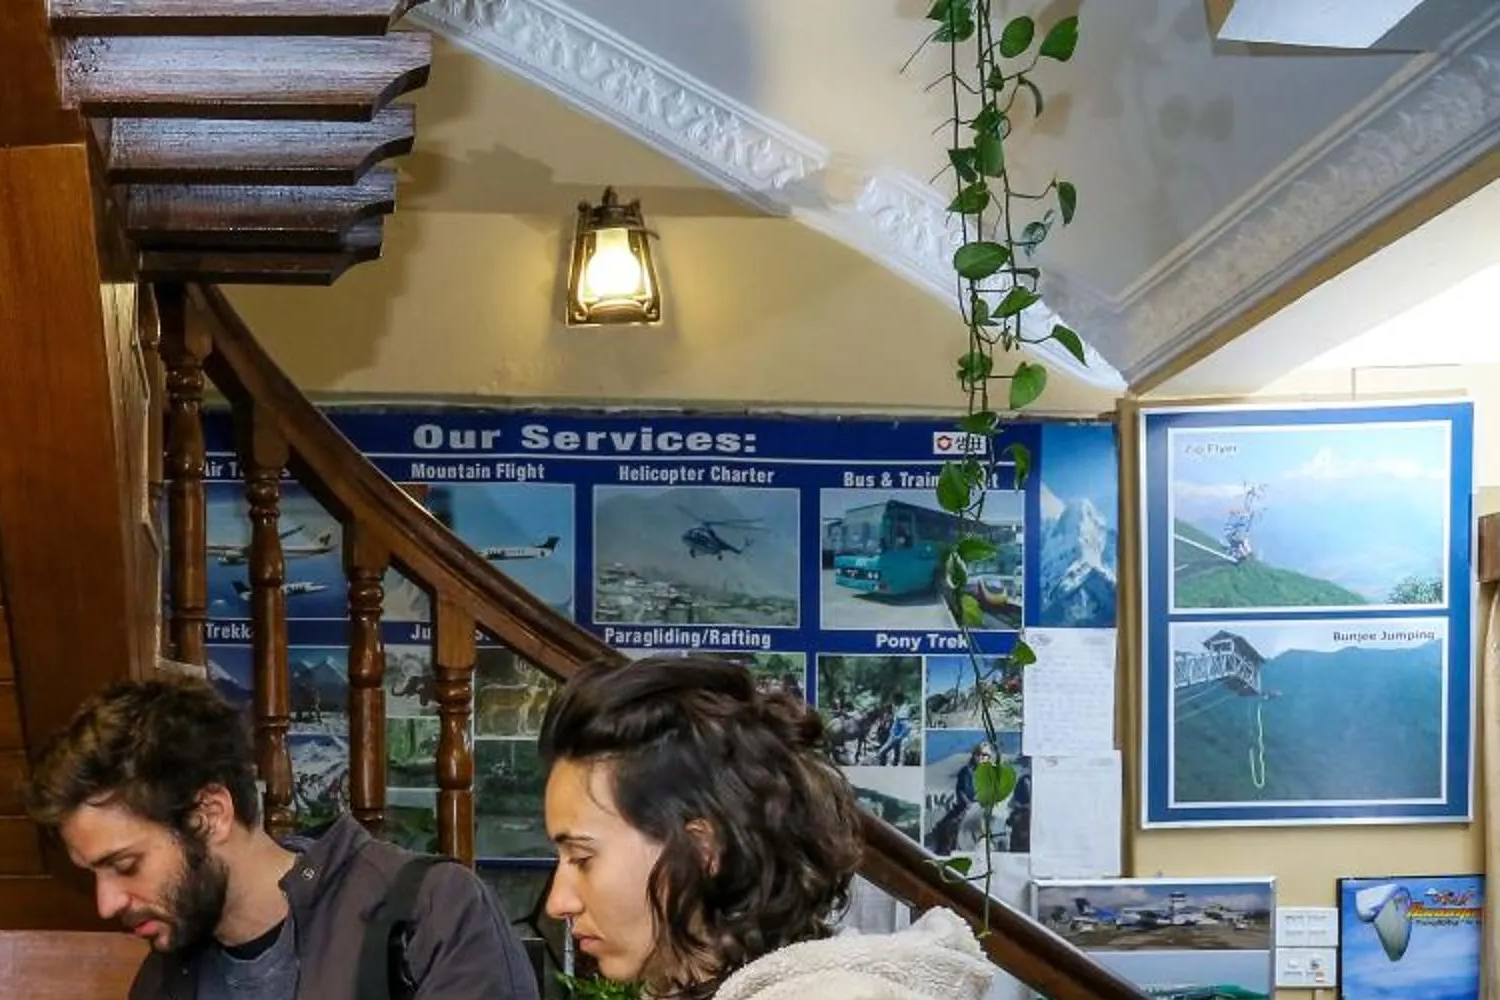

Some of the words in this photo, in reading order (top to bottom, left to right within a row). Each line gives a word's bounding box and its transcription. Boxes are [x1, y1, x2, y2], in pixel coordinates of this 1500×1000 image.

[413, 424, 501, 450] Our
[521, 423, 756, 453] Services:
[411, 463, 491, 480] Mountain
[496, 463, 546, 482] Flight
[618, 465, 706, 485] Helicopter
[710, 466, 776, 483] Charter
[843, 471, 875, 487] Bus
[881, 471, 893, 487] &
[205, 622, 251, 639] Trekk
[604, 627, 772, 649] Paragliding/Rafting
[1333, 631, 1377, 643] Bunjee
[1380, 630, 1436, 643] Jumping
[875, 633, 922, 652] Pony
[926, 633, 969, 649] Trek
